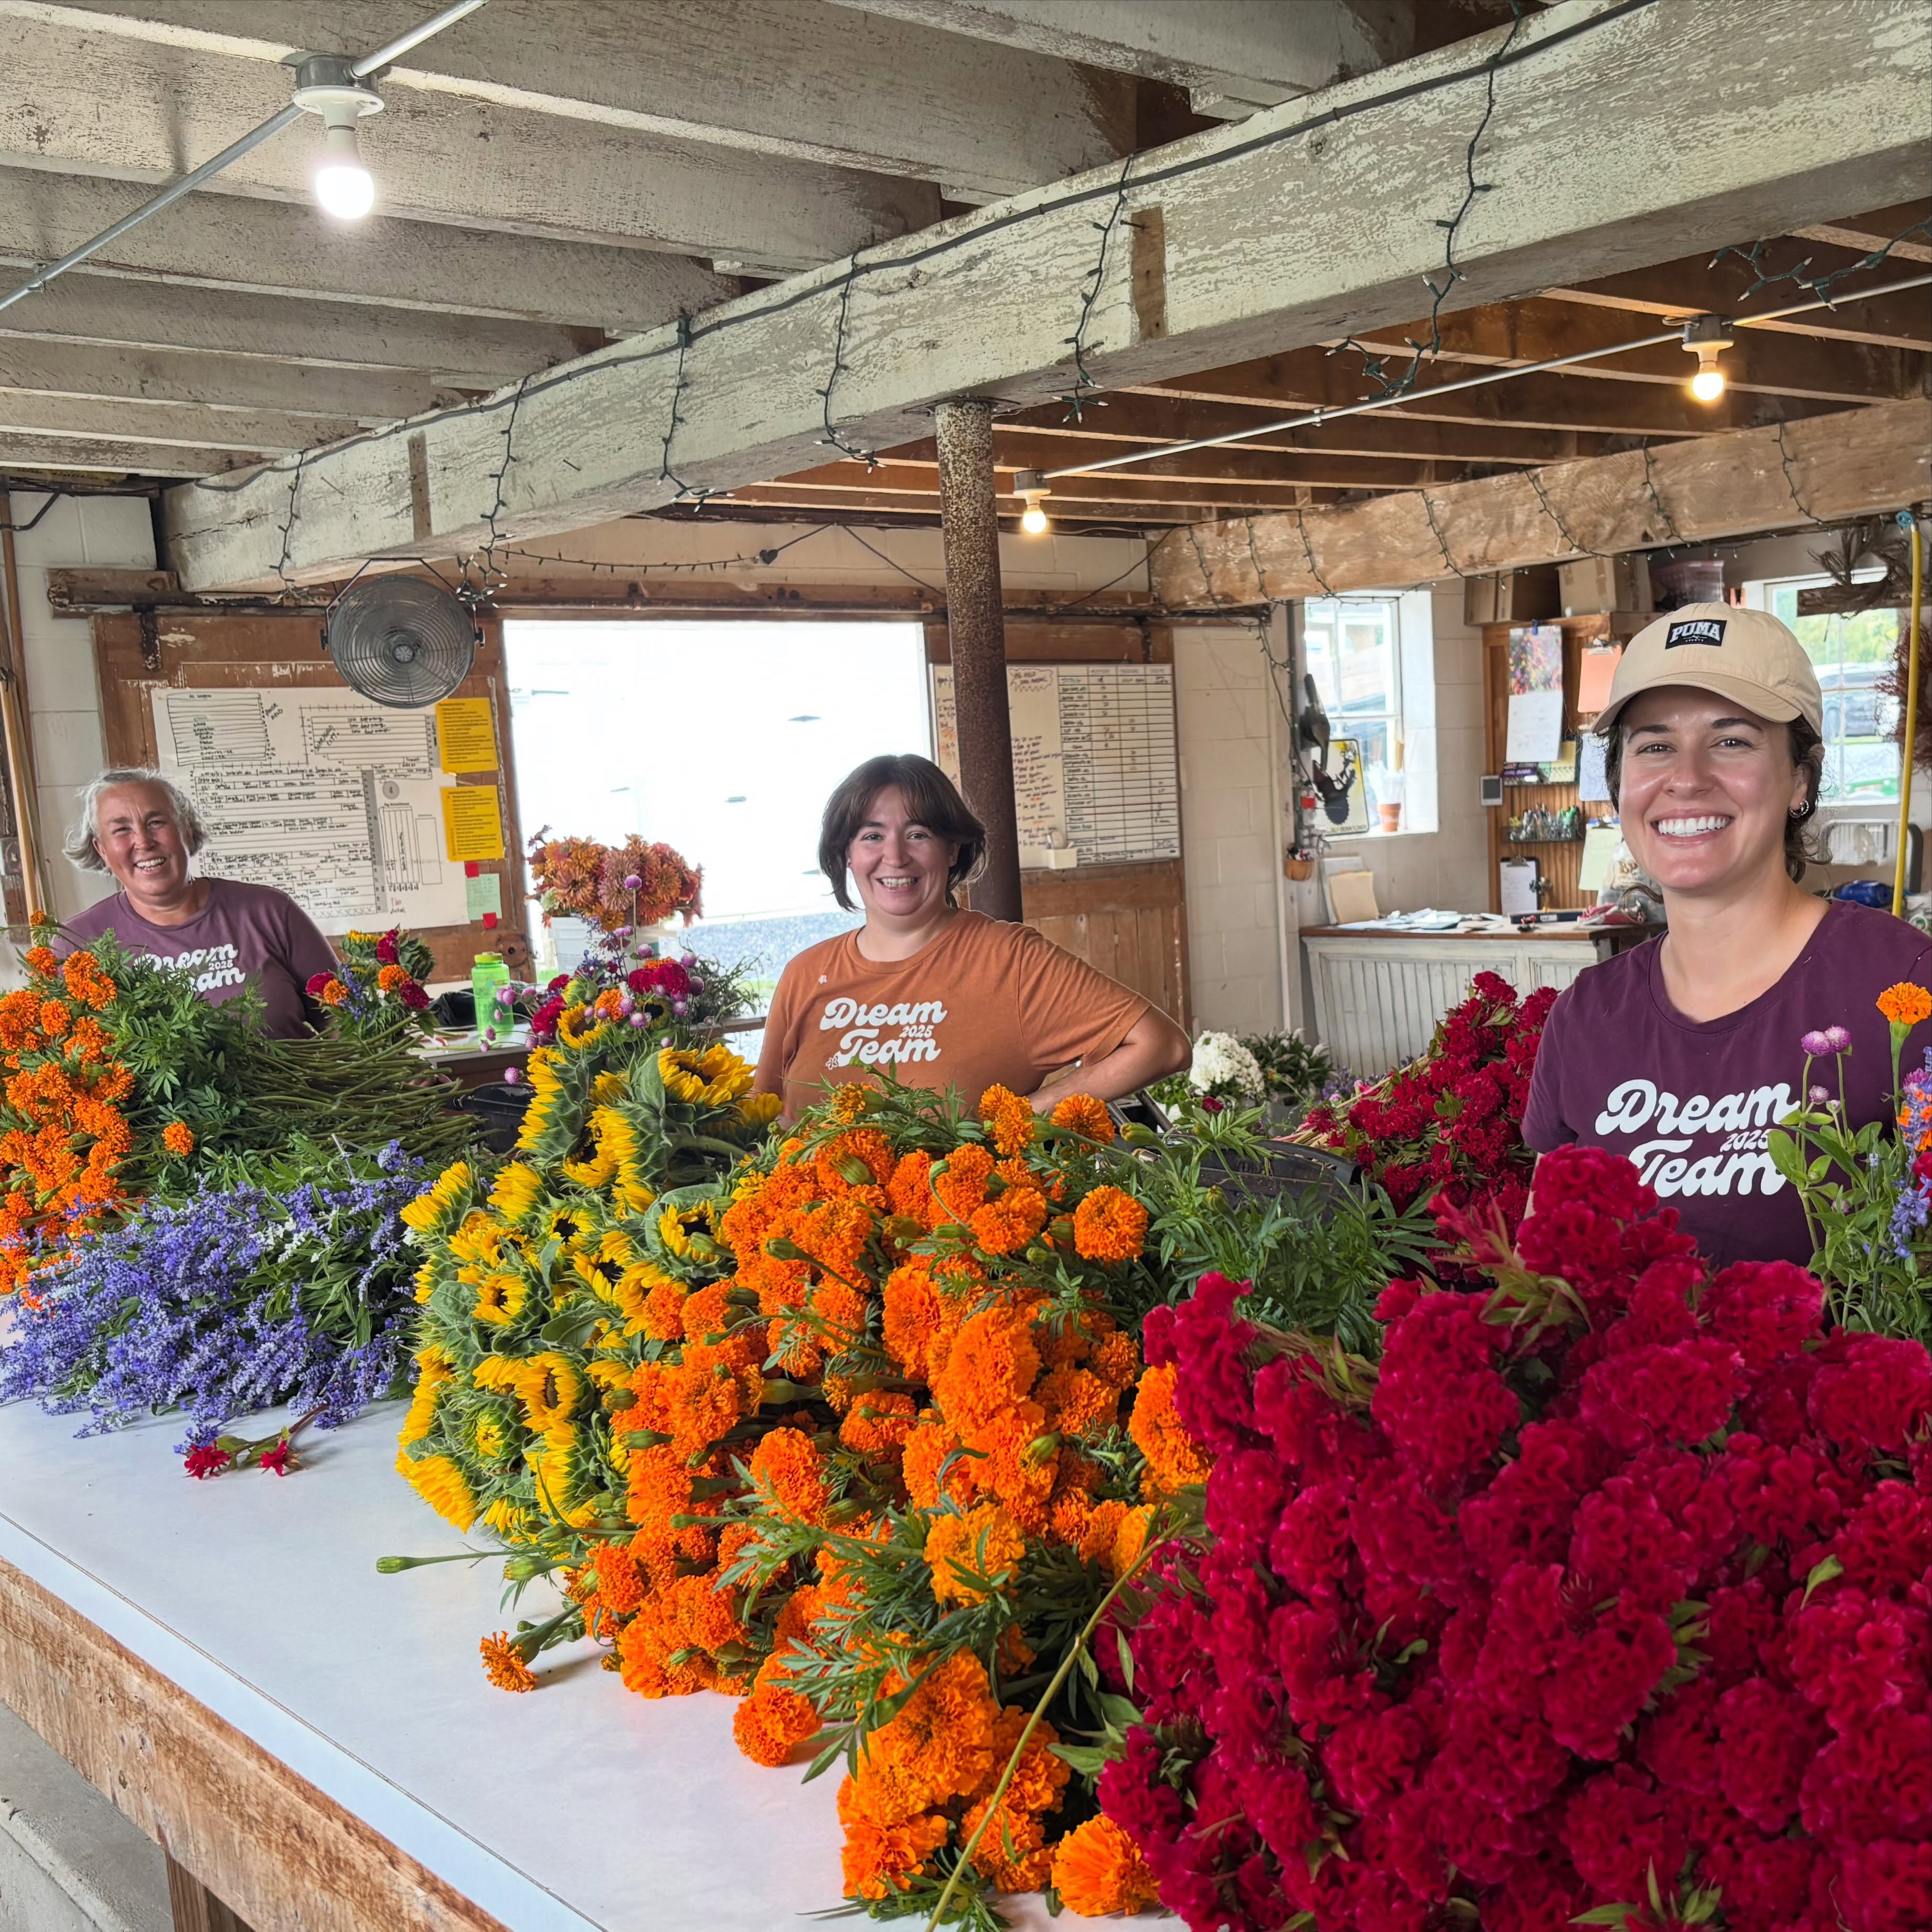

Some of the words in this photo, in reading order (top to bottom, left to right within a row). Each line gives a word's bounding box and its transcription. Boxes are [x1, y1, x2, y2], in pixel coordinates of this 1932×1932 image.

[1670, 622, 1721, 643] PUMA
[819, 997, 948, 1030] Dream
[834, 1029, 942, 1067] Team
[899, 1025, 935, 1038] 2025
[1595, 1079, 1801, 1135] Dream
[1628, 1139, 1790, 1198] Team
